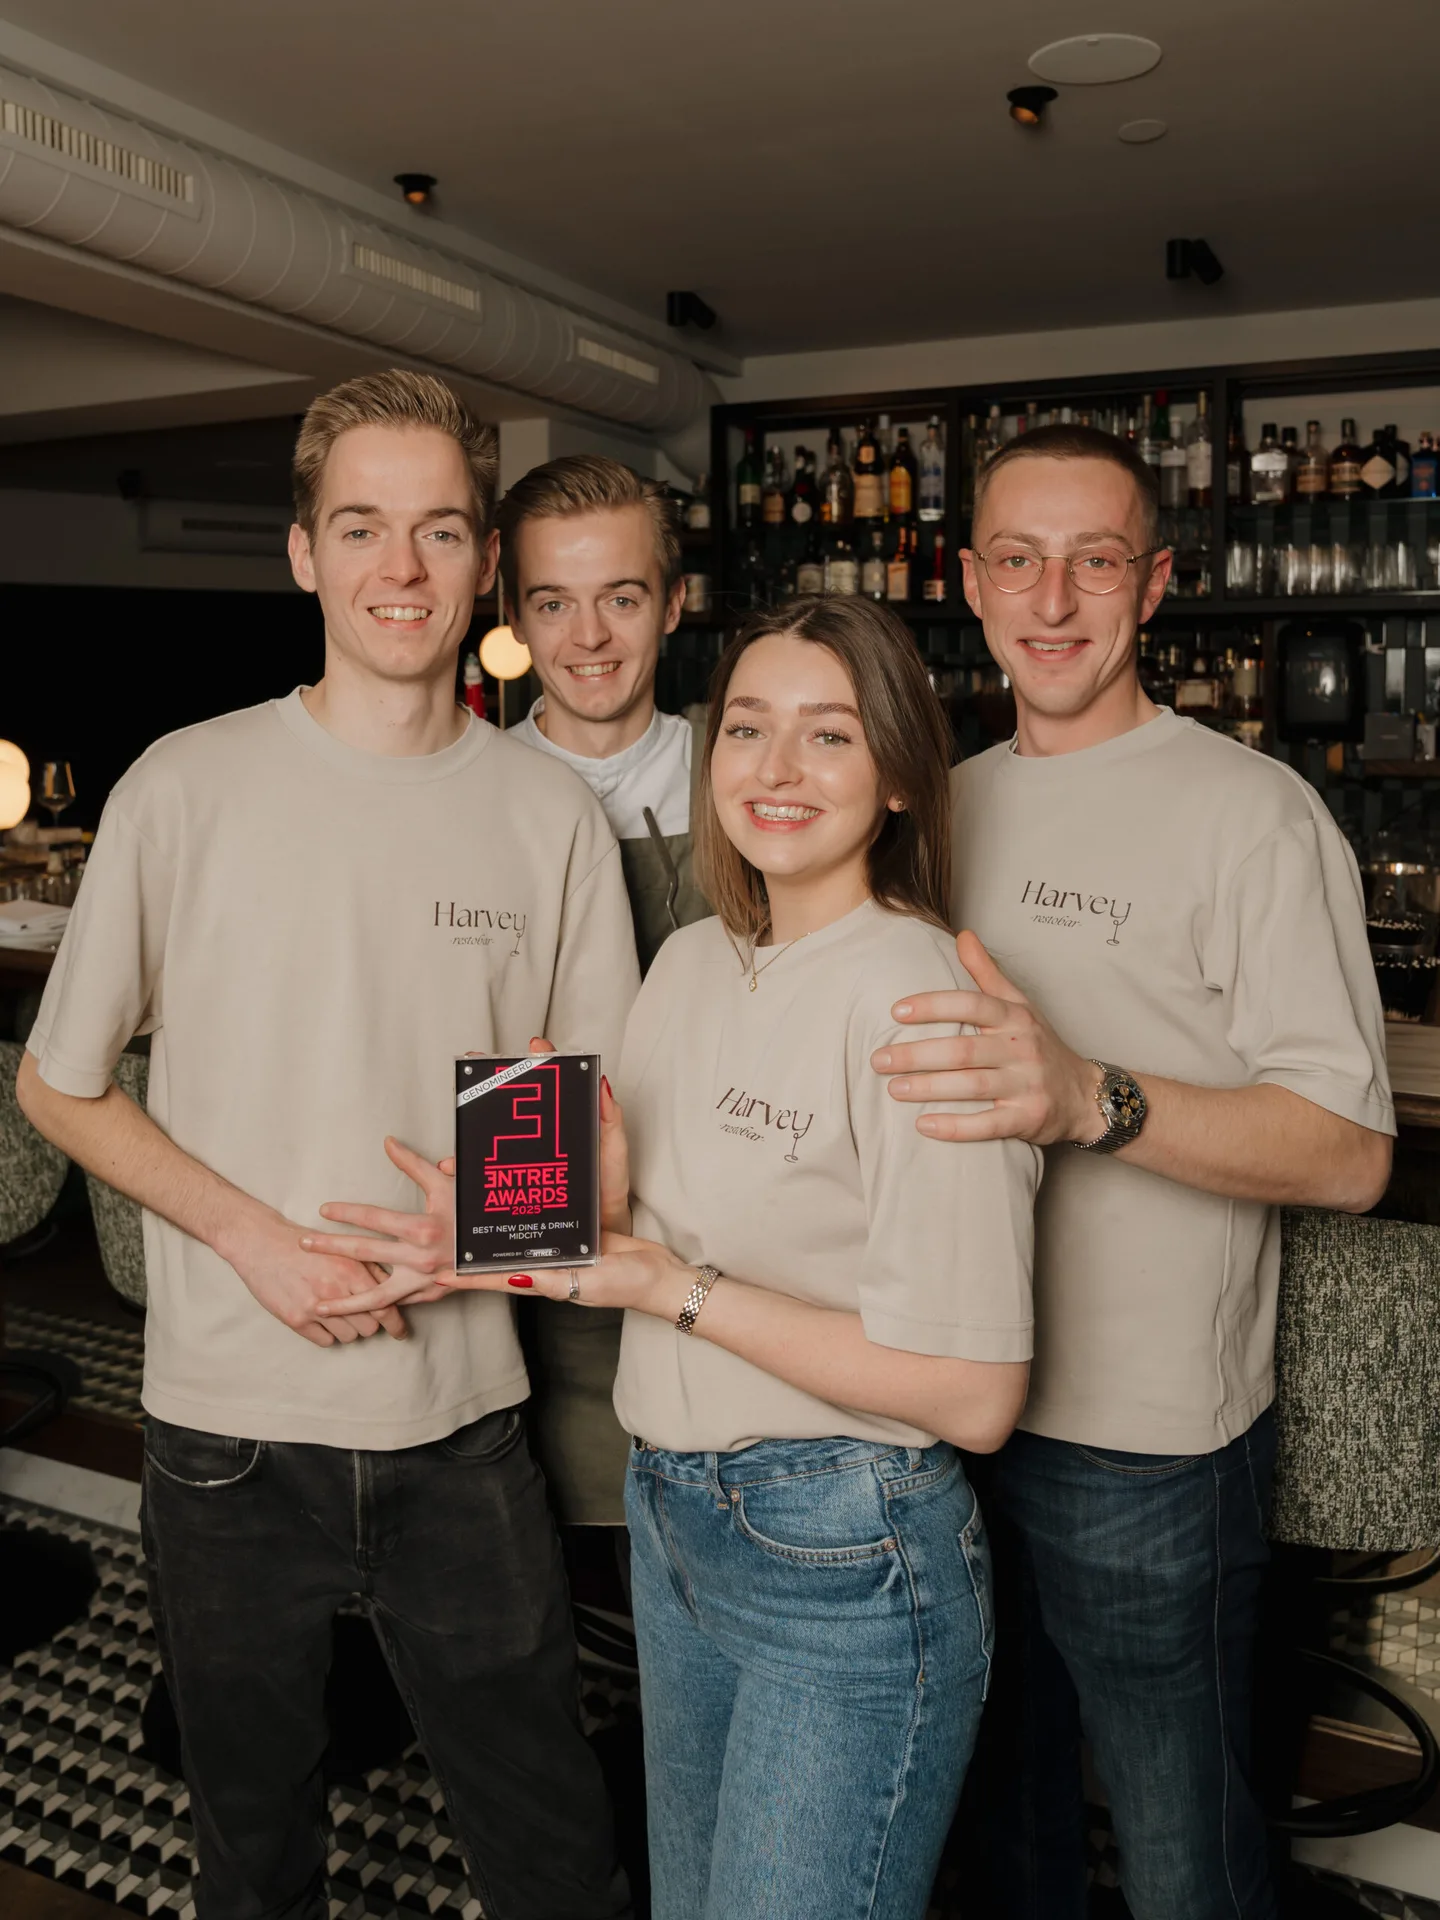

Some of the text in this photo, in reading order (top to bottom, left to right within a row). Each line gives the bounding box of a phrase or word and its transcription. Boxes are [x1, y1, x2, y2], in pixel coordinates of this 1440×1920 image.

[1021, 880, 1132, 946] Harvey
[434, 901, 526, 957] Harvey
[462, 1060, 533, 1101] GENOMINEERD
[716, 1087, 814, 1163] Harvey
[484, 1186, 568, 1206] AWARDS
[511, 1205, 542, 1215] 2025
[472, 1225, 494, 1234] BEST
[496, 1224, 516, 1232] NEW
[518, 1223, 538, 1231] DINE
[540, 1222, 546, 1230] &
[548, 1221, 574, 1229] DRINK
[509, 1231, 543, 1240] MIDCITY
